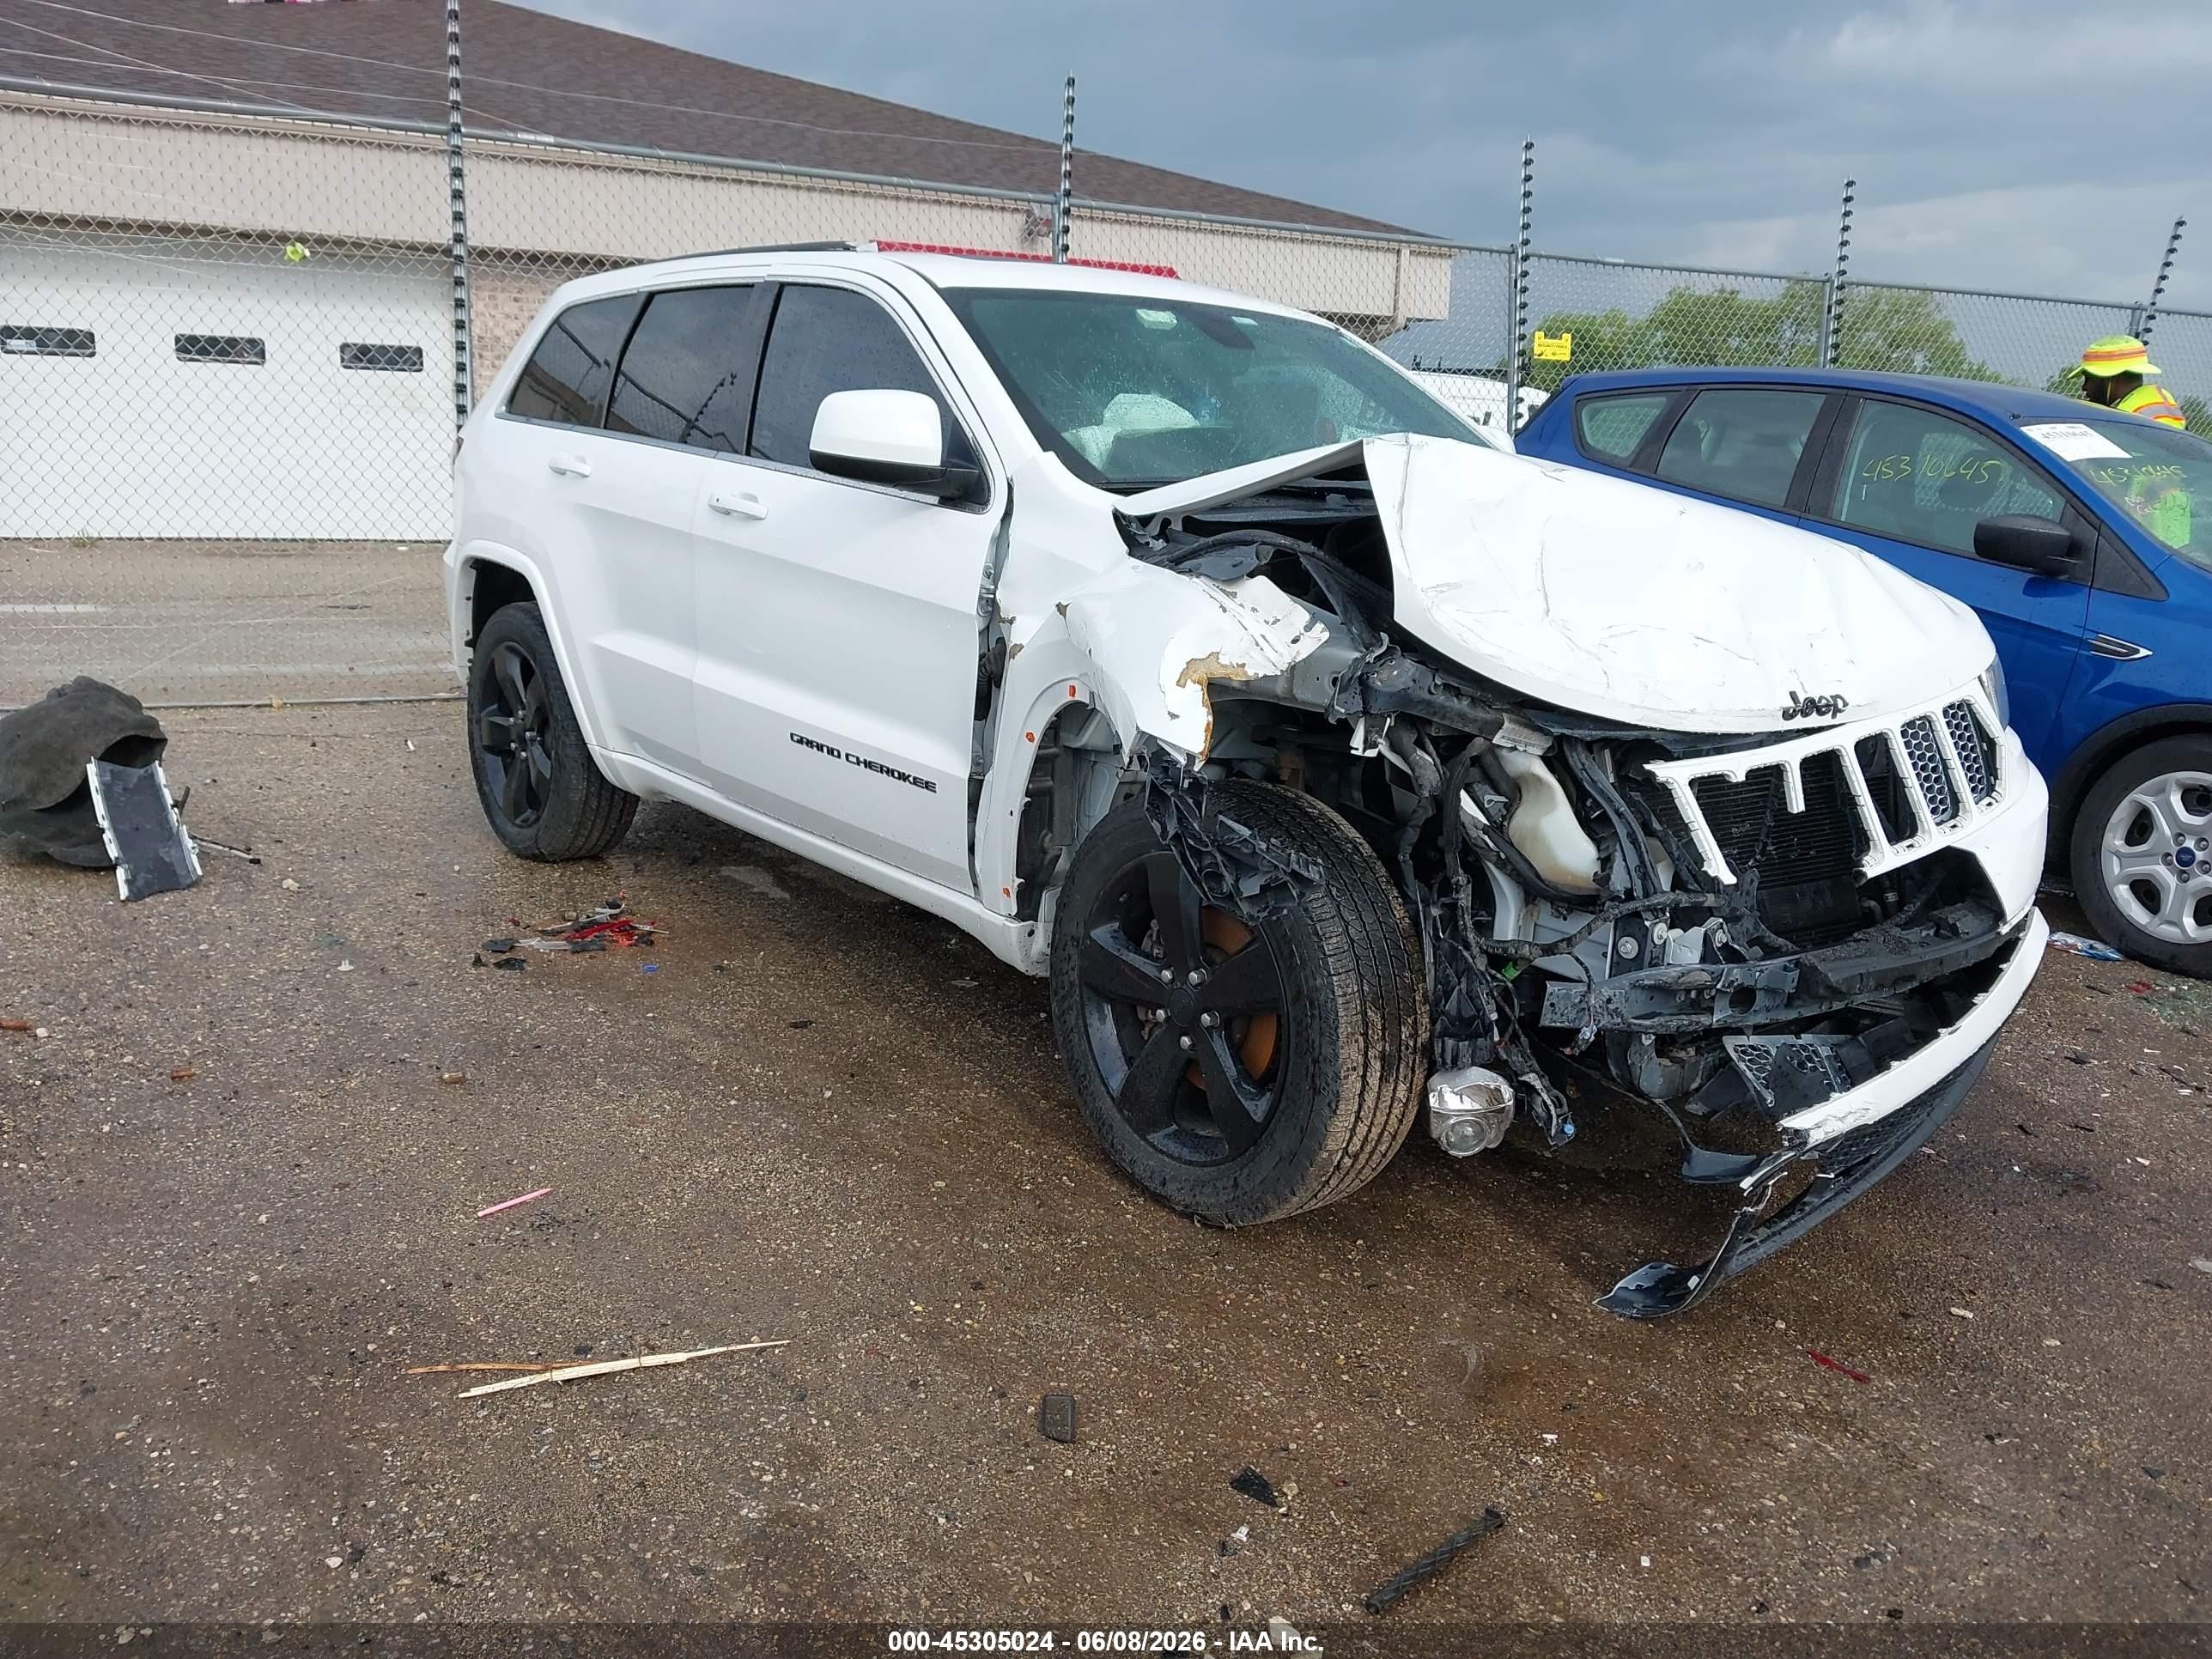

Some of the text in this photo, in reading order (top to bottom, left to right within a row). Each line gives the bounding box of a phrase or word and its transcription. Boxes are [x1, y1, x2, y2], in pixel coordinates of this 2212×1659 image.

[1782, 690, 1850, 721] Jeep
[789, 732, 938, 793] GRAND CHEROKEE
